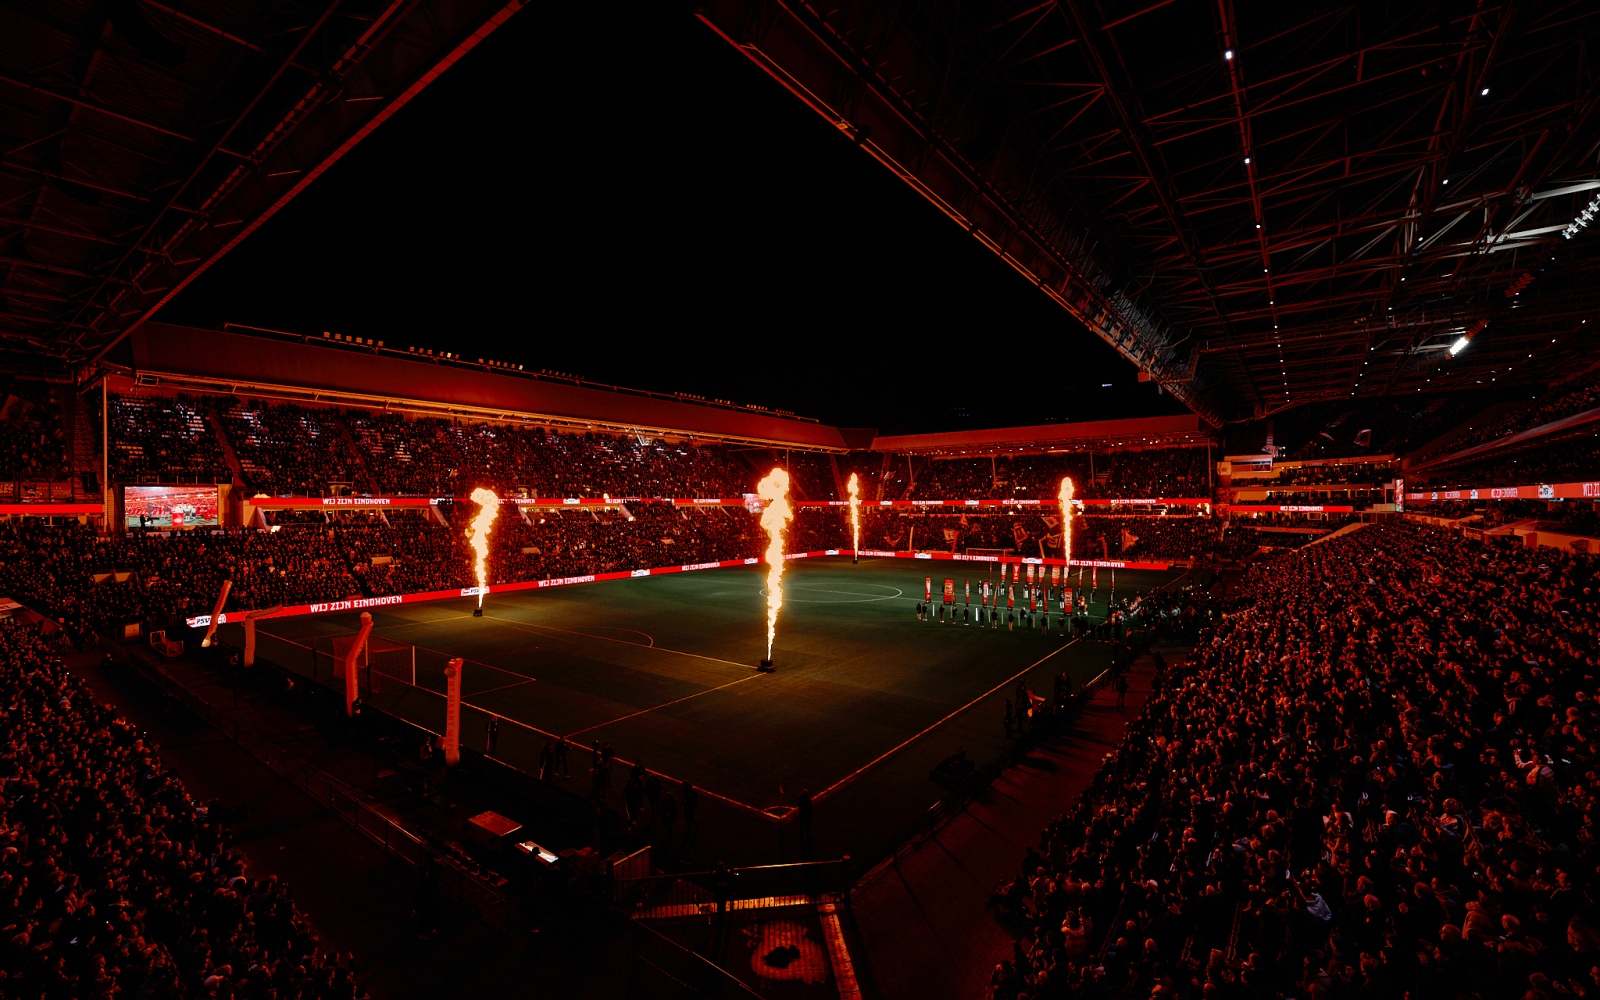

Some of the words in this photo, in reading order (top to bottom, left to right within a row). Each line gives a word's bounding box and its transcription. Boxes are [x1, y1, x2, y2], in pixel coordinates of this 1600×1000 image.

[310, 604, 328, 612] WIJ
[330, 601, 350, 611] ZIJN
[354, 596, 402, 608] EINDHOVEN
